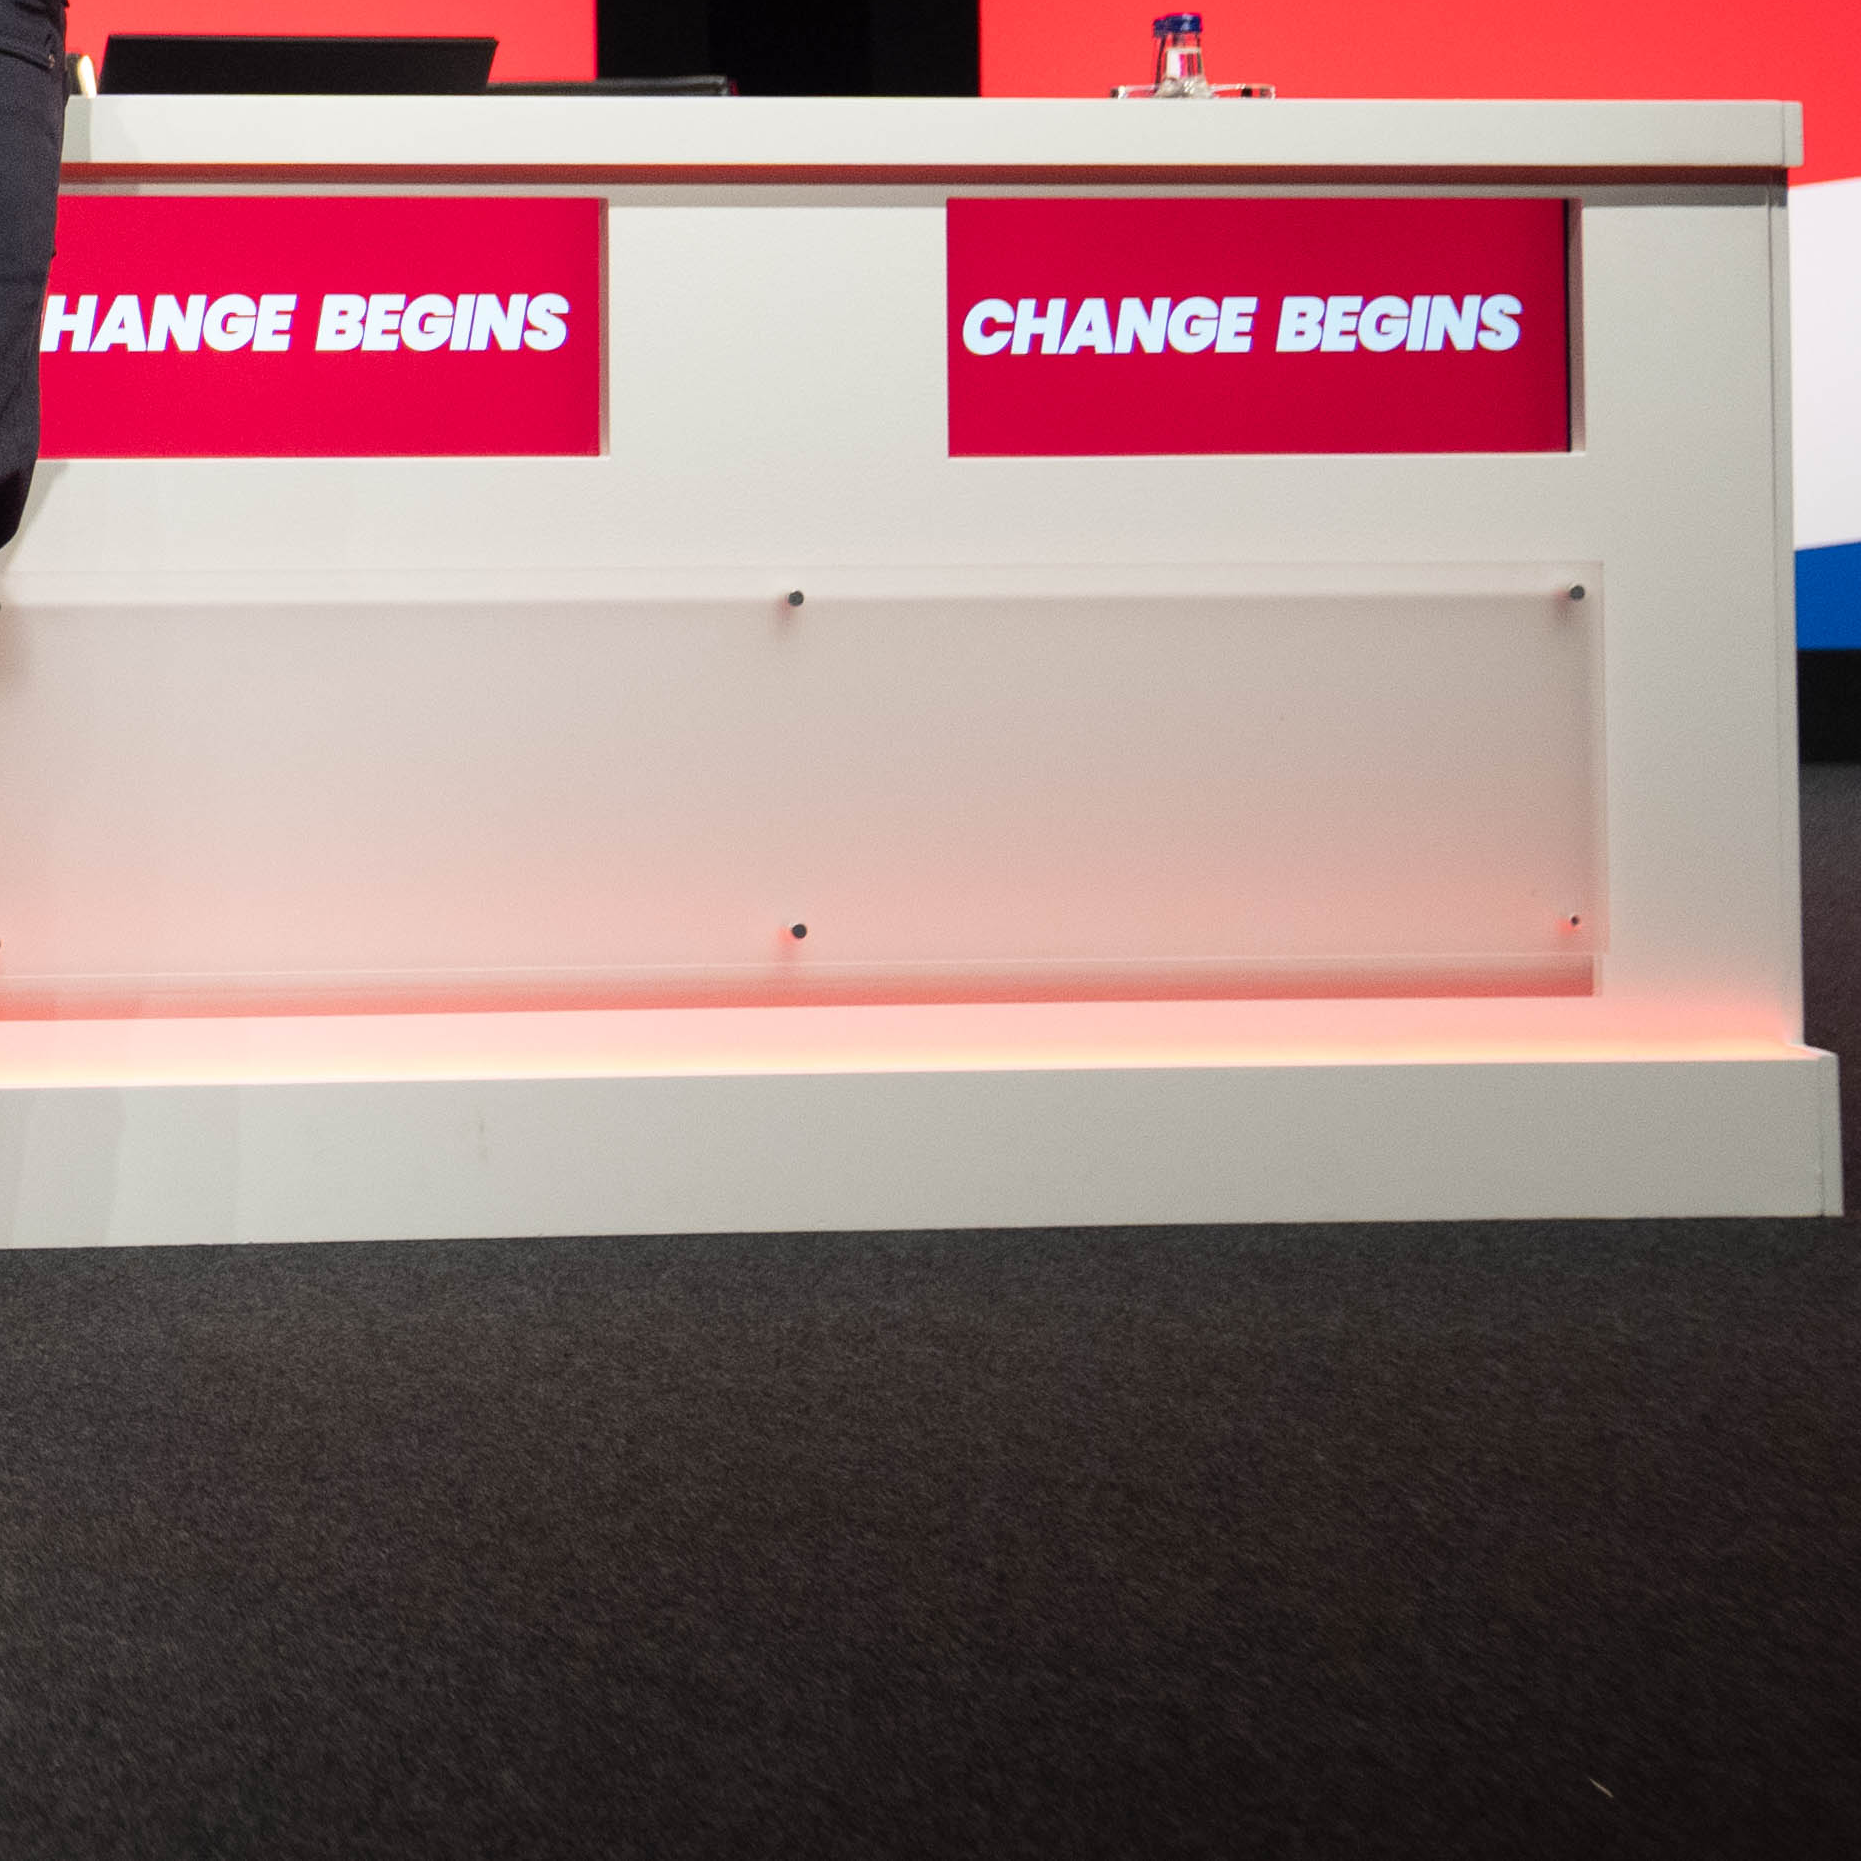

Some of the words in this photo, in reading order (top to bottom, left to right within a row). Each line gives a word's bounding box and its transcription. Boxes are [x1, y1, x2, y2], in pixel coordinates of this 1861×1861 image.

[39, 293, 298, 353] HANGE
[314, 292, 571, 352] BEGINS
[962, 296, 1258, 356] CHANGE
[1275, 293, 1523, 353] BEGINS
